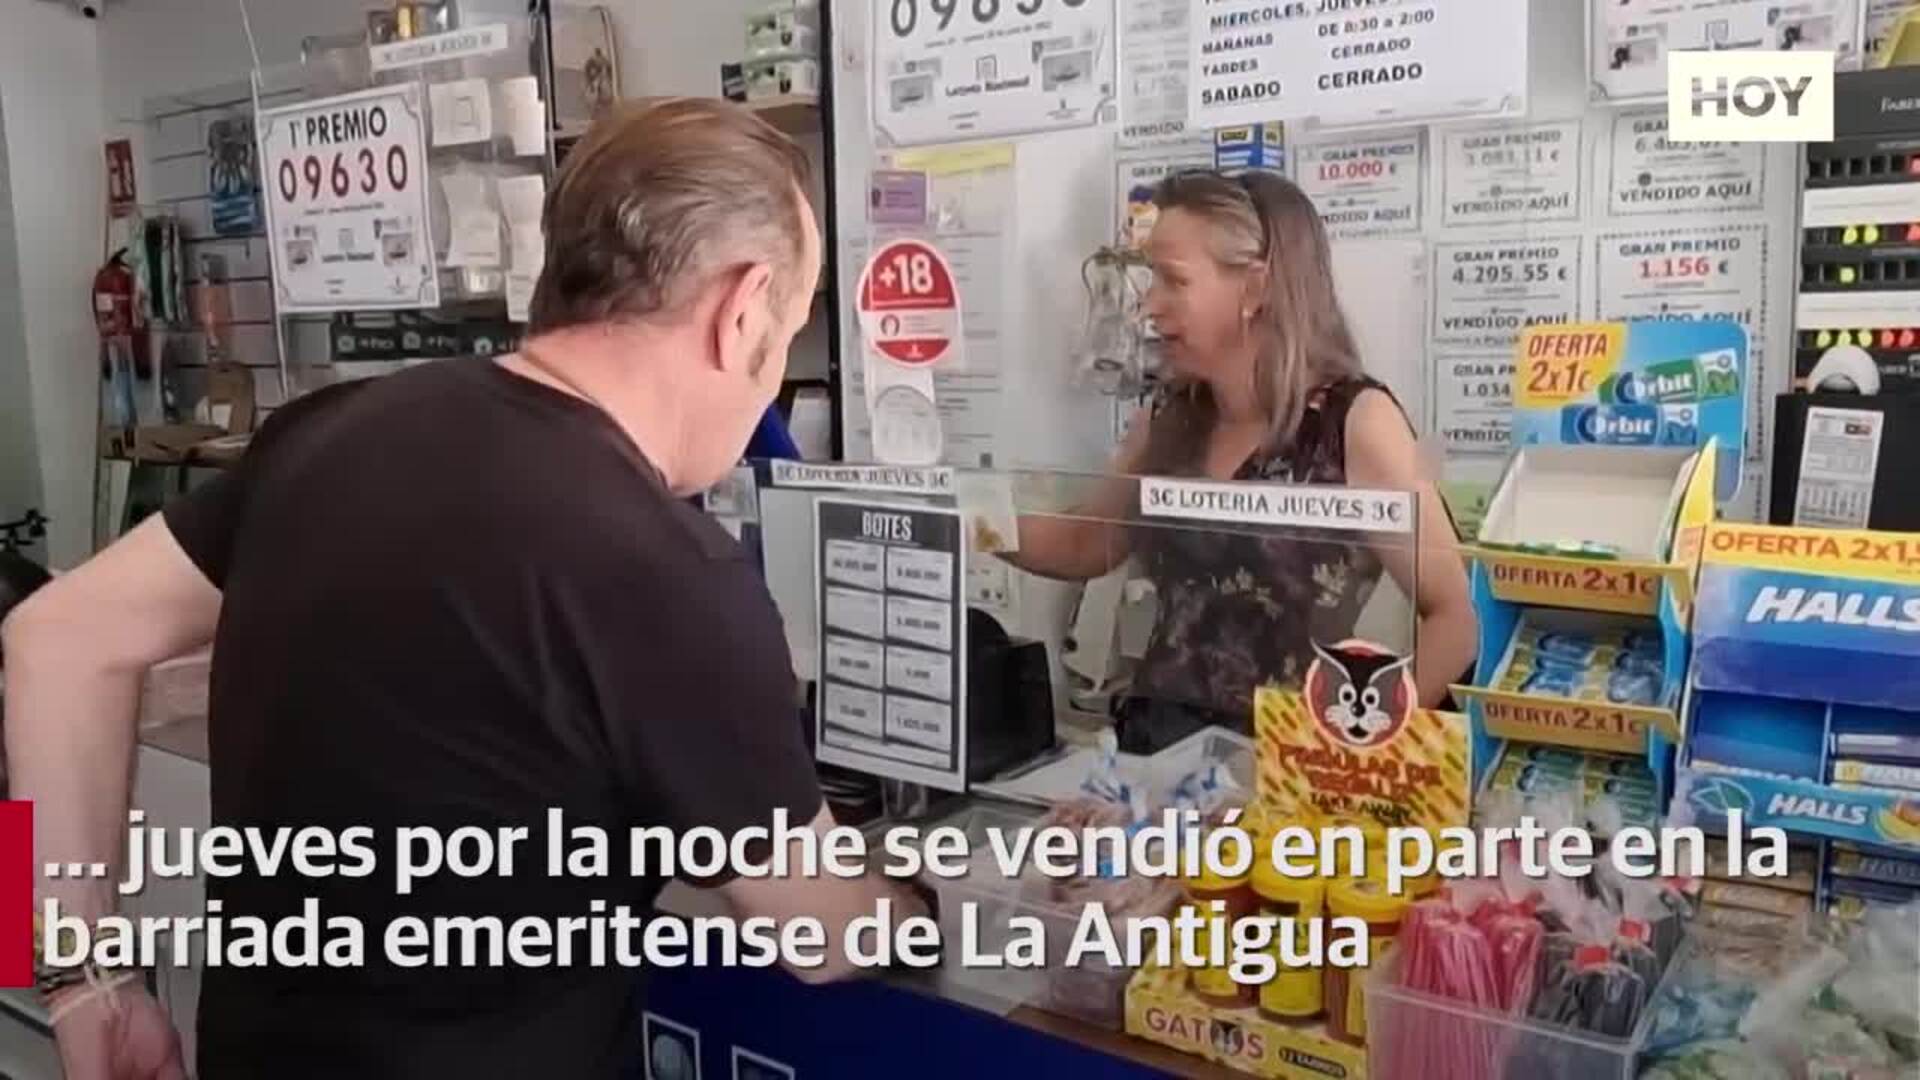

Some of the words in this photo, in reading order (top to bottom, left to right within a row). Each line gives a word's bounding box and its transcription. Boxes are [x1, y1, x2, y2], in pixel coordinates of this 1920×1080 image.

[1318, 23, 1339, 37] DE
[1400, 9, 1435, 25] 2:00
[1331, 37, 1412, 60] CERRADO
[1318, 63, 1423, 90] CERRADO
[1201, 81, 1281, 105] SABADO
[306, 106, 387, 146] PREMIO
[279, 144, 408, 203] 09630
[1319, 160, 1383, 181] 10.000
[1451, 200, 1523, 215] VENDIDO
[1527, 192, 1569, 211] AQUÍ
[1619, 185, 1701, 203] VENDIDO
[1705, 180, 1752, 200] AQUÍ
[1453, 250, 1494, 263] GRAN
[1499, 246, 1560, 261] PREMIO
[1619, 241, 1666, 256] GRAN
[1671, 237, 1741, 252] PREMIO
[878, 252, 934, 295] +18
[1639, 255, 1710, 279] 1.156
[1442, 314, 1519, 329] VENDIDO
[1527, 333, 1608, 358] OFERTA
[1453, 364, 1494, 377] GRAN
[1578, 406, 1654, 443] Orbit
[867, 471, 925, 486] JUEVES
[1179, 488, 1269, 513] LOTERIA
[1277, 496, 1364, 518] JUEVES
[862, 510, 912, 541] BOTES
[1712, 531, 1840, 558] OFERTA
[1494, 563, 1577, 588] OFERTA
[1747, 586, 1920, 631] HALLS
[1486, 703, 1567, 728] OFERTA
[1767, 793, 1868, 825] HALLS
